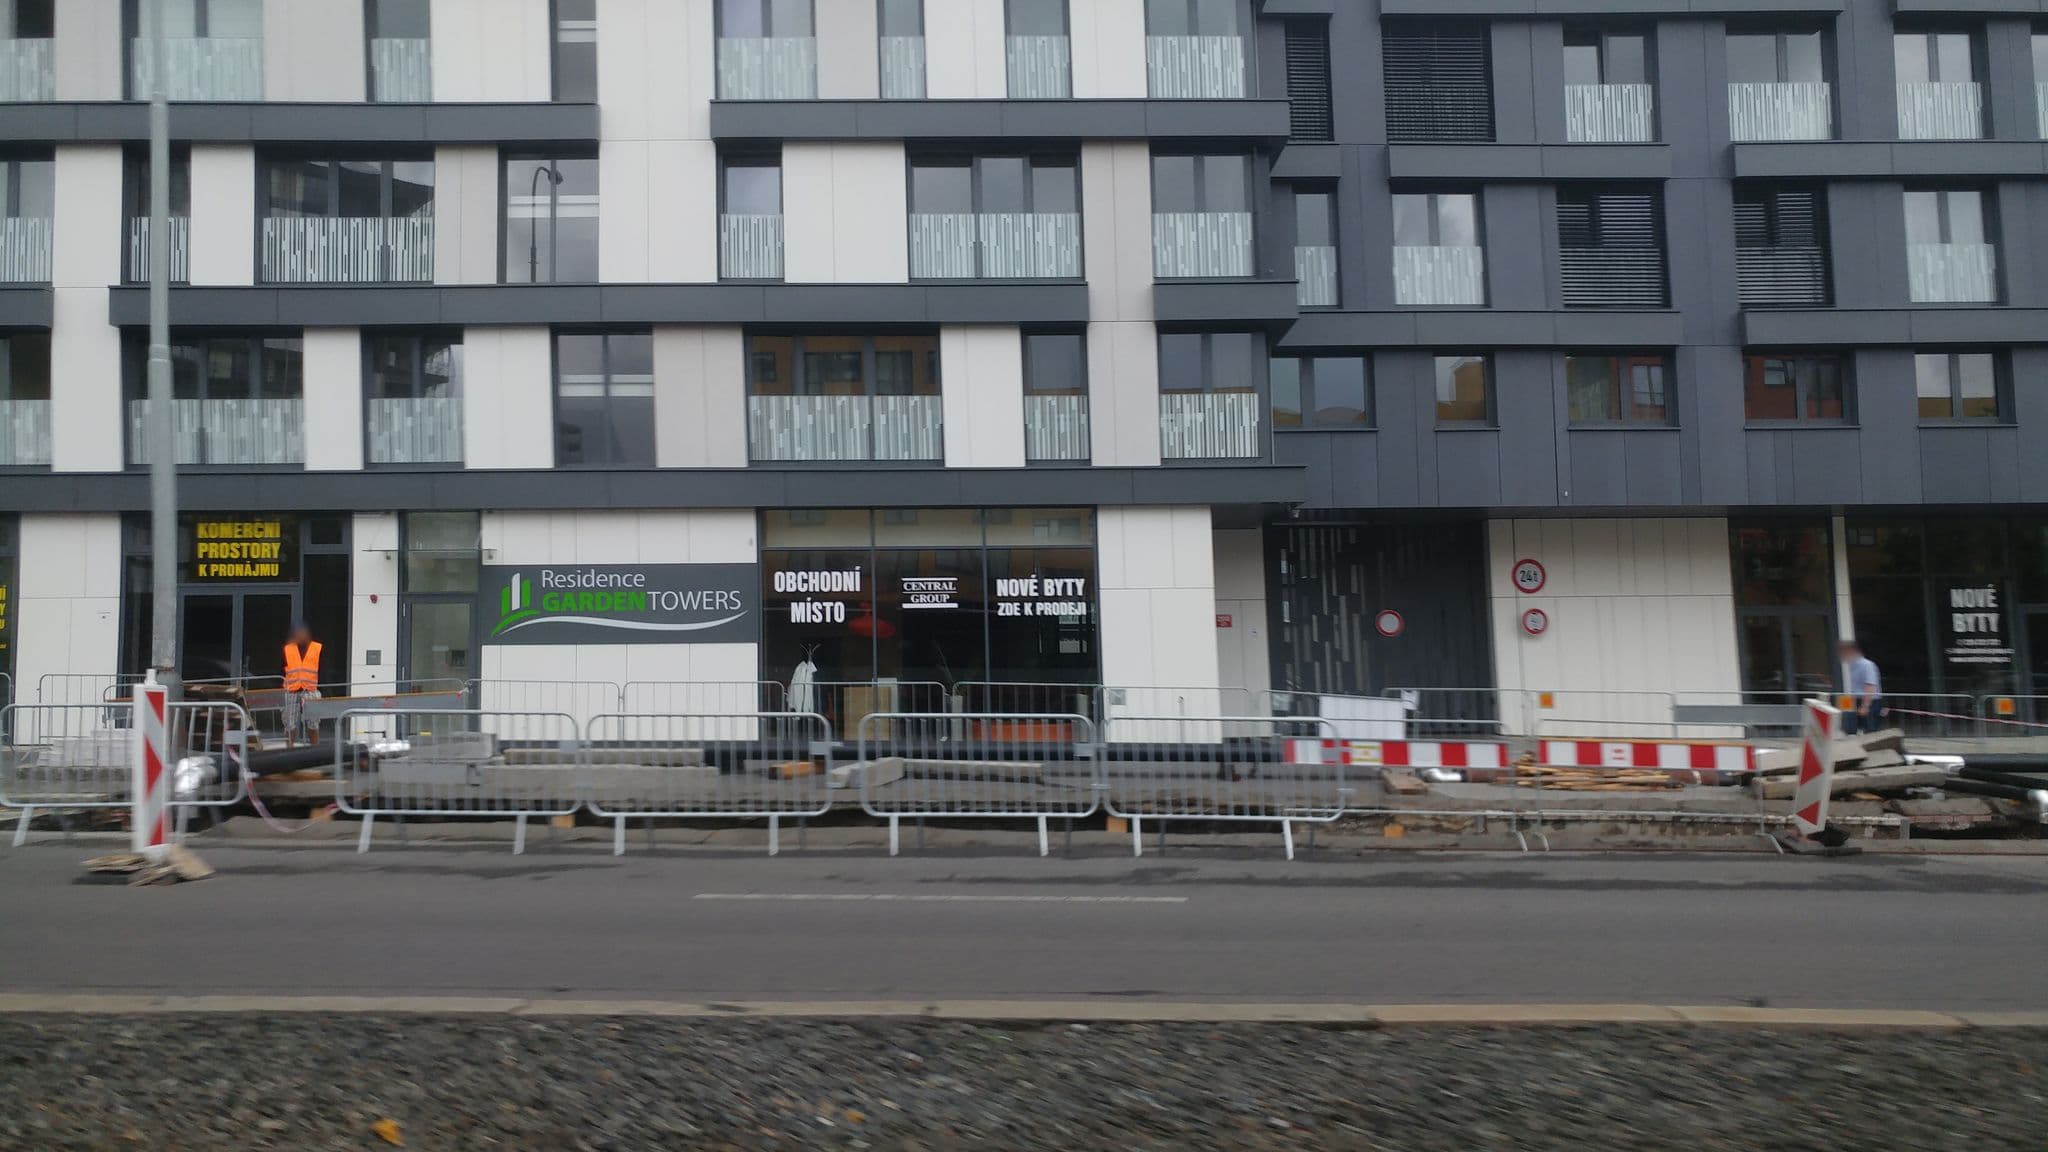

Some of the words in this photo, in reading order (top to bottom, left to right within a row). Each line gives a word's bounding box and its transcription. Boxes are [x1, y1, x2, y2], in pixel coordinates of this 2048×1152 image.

[197, 518, 281, 539] KOMERČNÍ
[197, 542, 281, 559] PROSTORY
[199, 563, 208, 577] K
[210, 560, 279, 577] PRONÁJMU
[541, 569, 646, 588] Residence
[773, 565, 861, 593] OBCHODNÍ
[902, 581, 957, 592] CENTRAL
[996, 574, 1039, 597] NOVÉ
[1043, 578, 1085, 597] BYTY
[910, 593, 950, 604] GROUP
[1950, 583, 1999, 608] NOVÉ
[790, 597, 846, 624] MÍSTO
[997, 602, 1021, 616] ZDE
[1023, 602, 1033, 616] K
[1035, 601, 1087, 616] PRODEJI
[1952, 612, 2000, 633] BYTY
